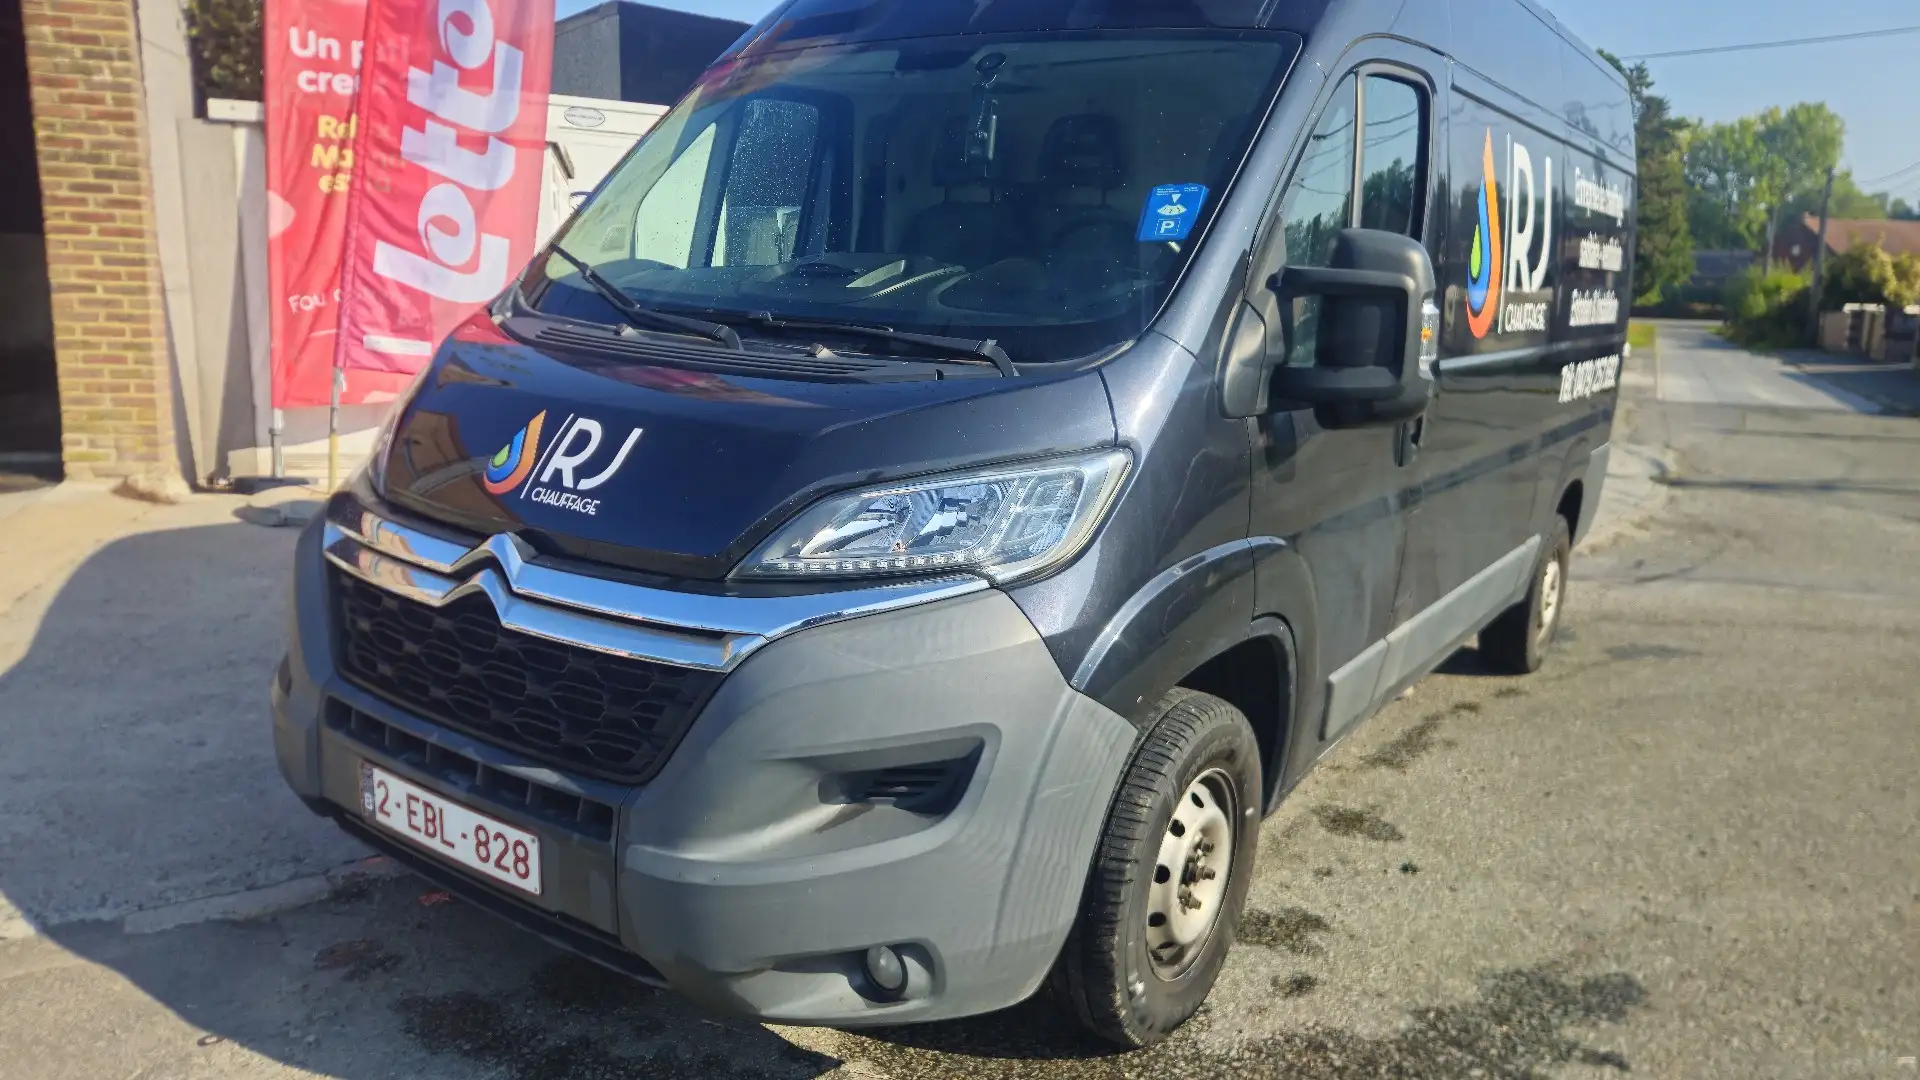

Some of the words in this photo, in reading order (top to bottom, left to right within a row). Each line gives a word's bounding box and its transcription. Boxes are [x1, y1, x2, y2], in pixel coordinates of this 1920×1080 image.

[289, 26, 341, 61] Un
[372, 0, 523, 304] Lotto
[1160, 220, 1175, 234] P
[1507, 141, 1552, 293] RJ
[1505, 302, 1547, 332] CHAUFFAGE
[540, 417, 644, 490] RJ
[531, 487, 601, 515] CHAUFFAGE
[376, 779, 530, 880] 2-EBL-828
